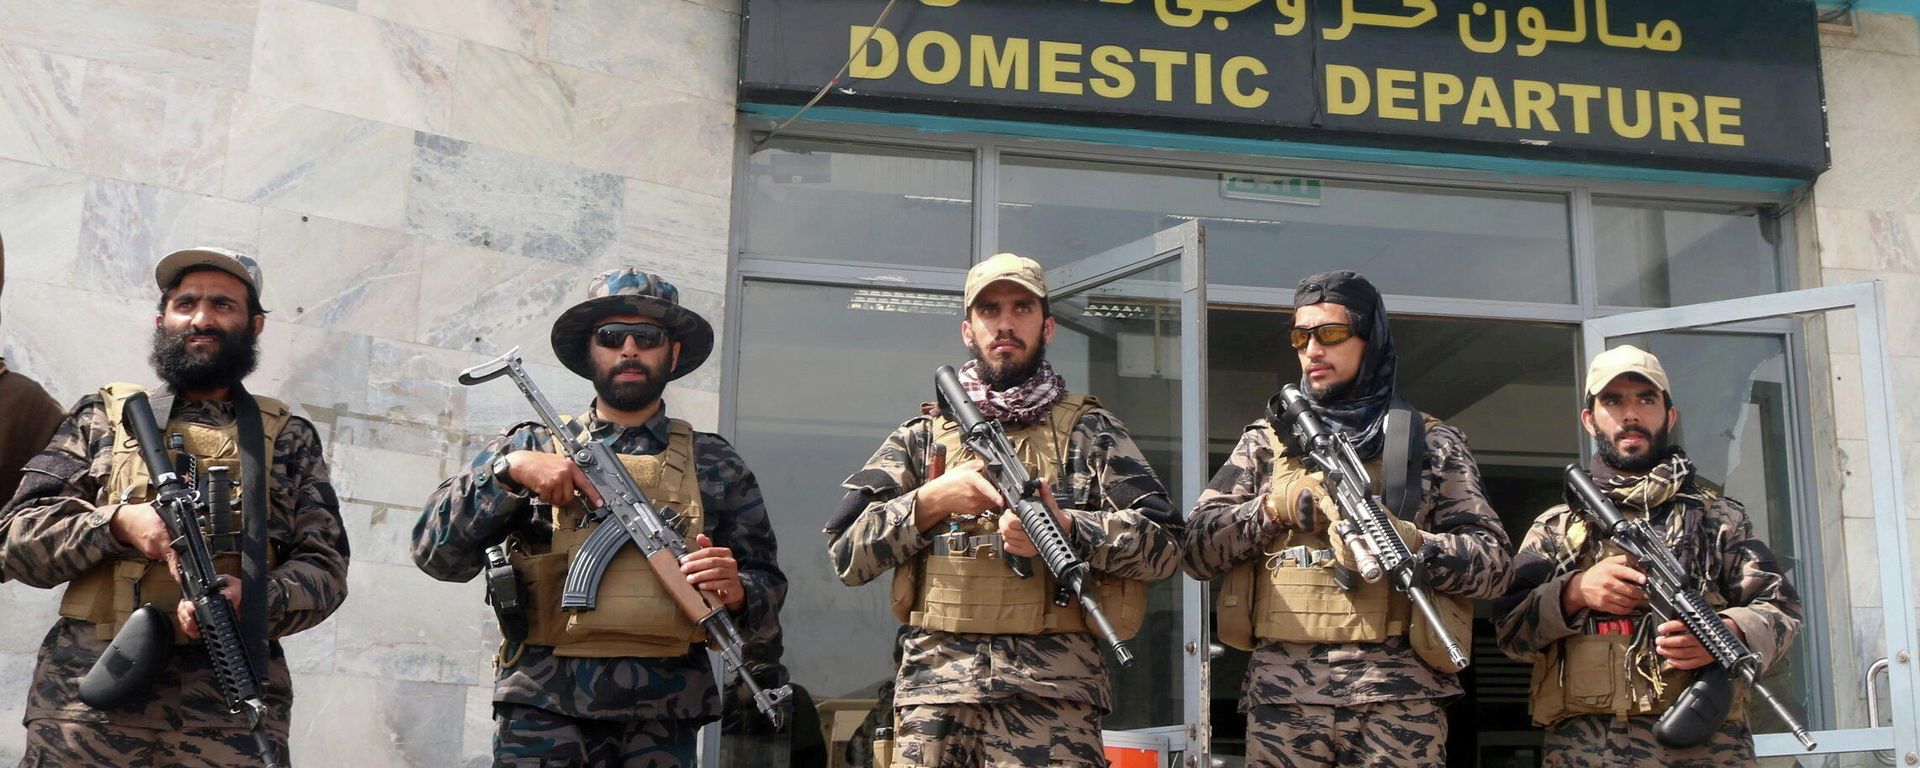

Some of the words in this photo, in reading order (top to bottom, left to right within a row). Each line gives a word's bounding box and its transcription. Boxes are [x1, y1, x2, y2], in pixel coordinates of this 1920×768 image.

[1458, 0, 1682, 57] صالون
[847, 24, 1270, 109] DOMESTIC
[1325, 63, 1745, 145] DEPARTURE
